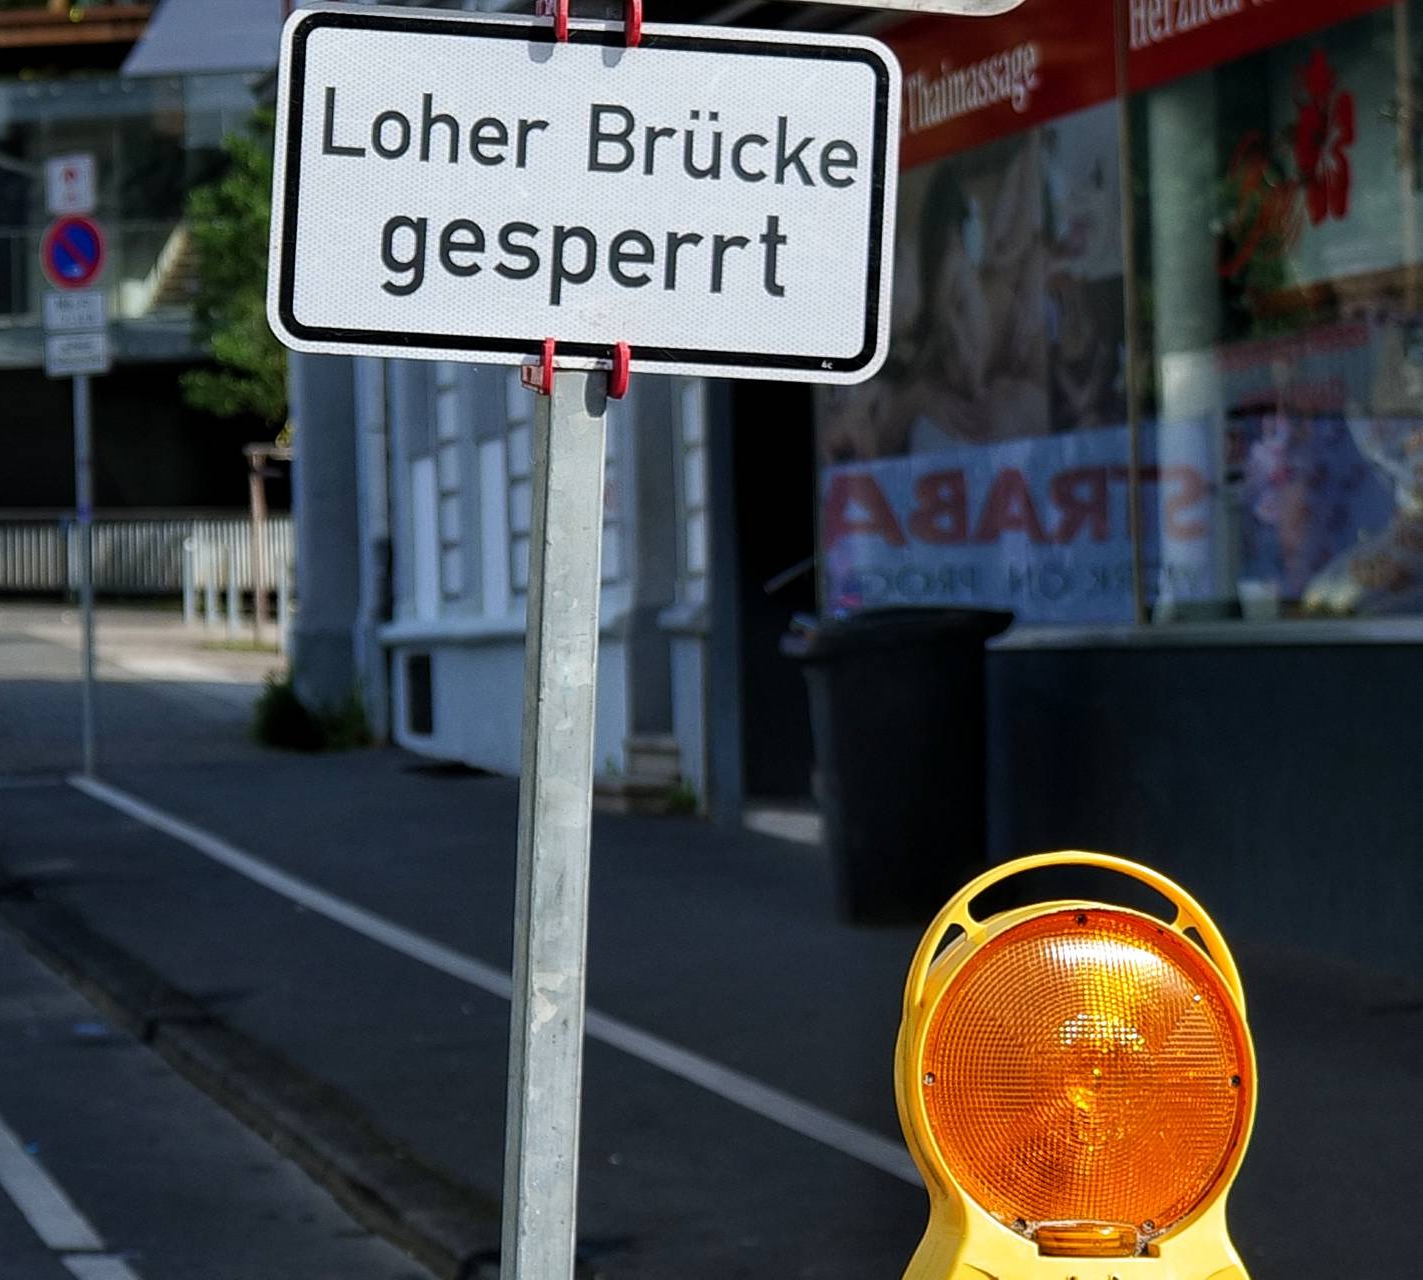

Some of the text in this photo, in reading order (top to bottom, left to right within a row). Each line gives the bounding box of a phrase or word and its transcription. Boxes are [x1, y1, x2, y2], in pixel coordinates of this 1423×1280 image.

[1129, 0, 1246, 48] Herz
[322, 86, 859, 188] Loher Brücke
[380, 214, 788, 306] gesperrt
